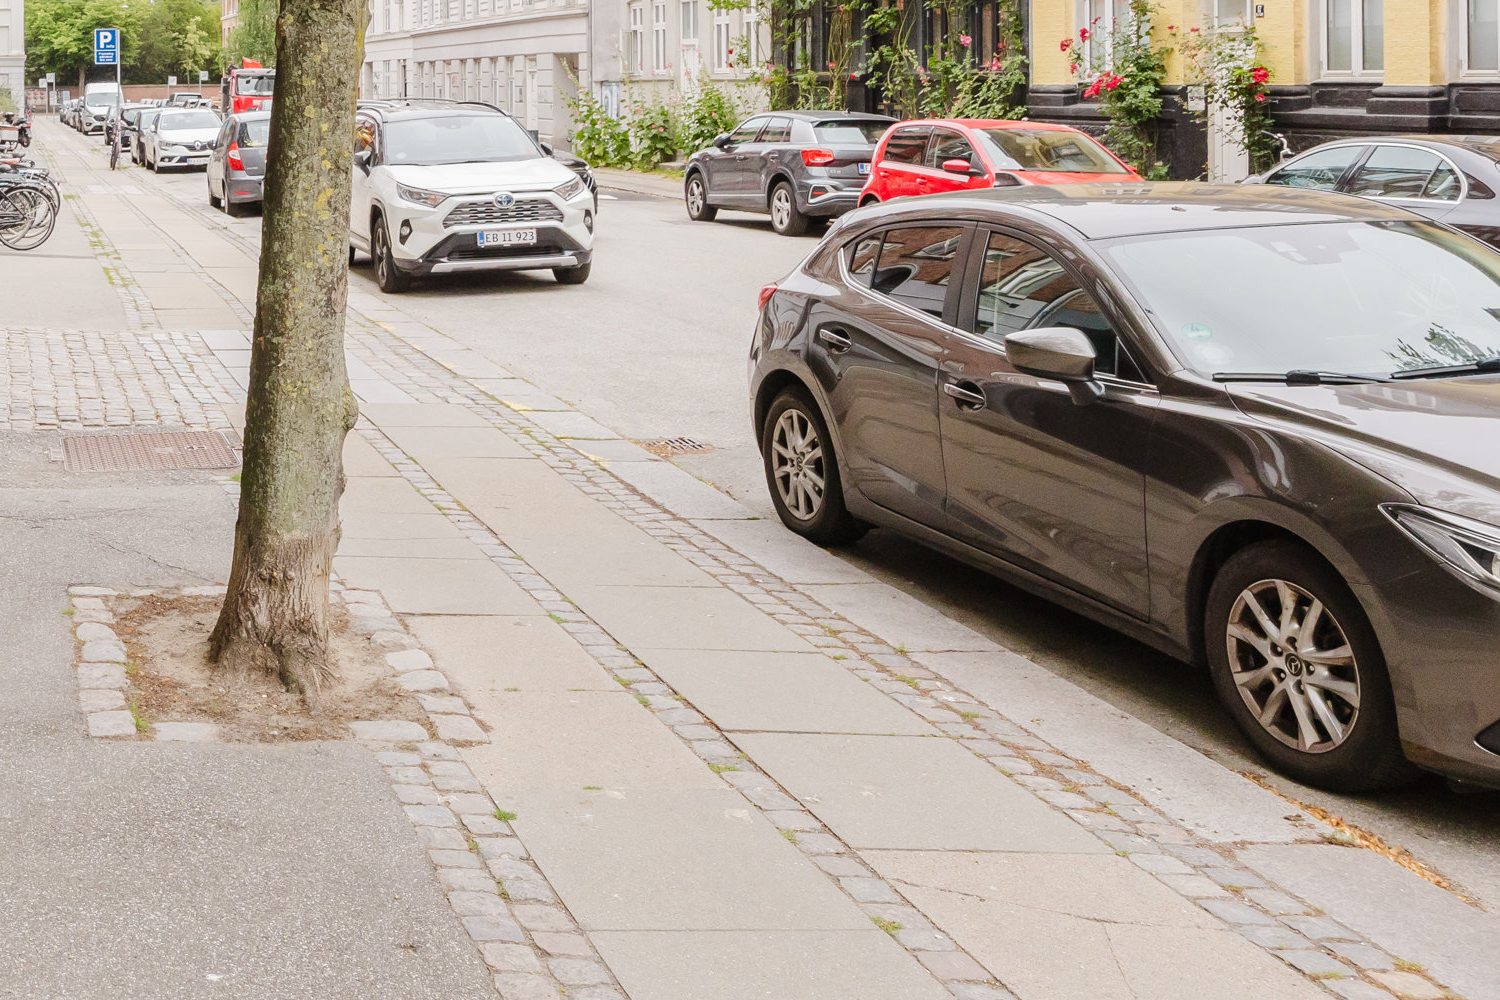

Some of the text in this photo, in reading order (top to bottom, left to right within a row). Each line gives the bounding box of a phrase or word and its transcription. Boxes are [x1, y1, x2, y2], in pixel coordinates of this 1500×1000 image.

[99, 31, 112, 48] P
[485, 231, 535, 243] EB 11 923
